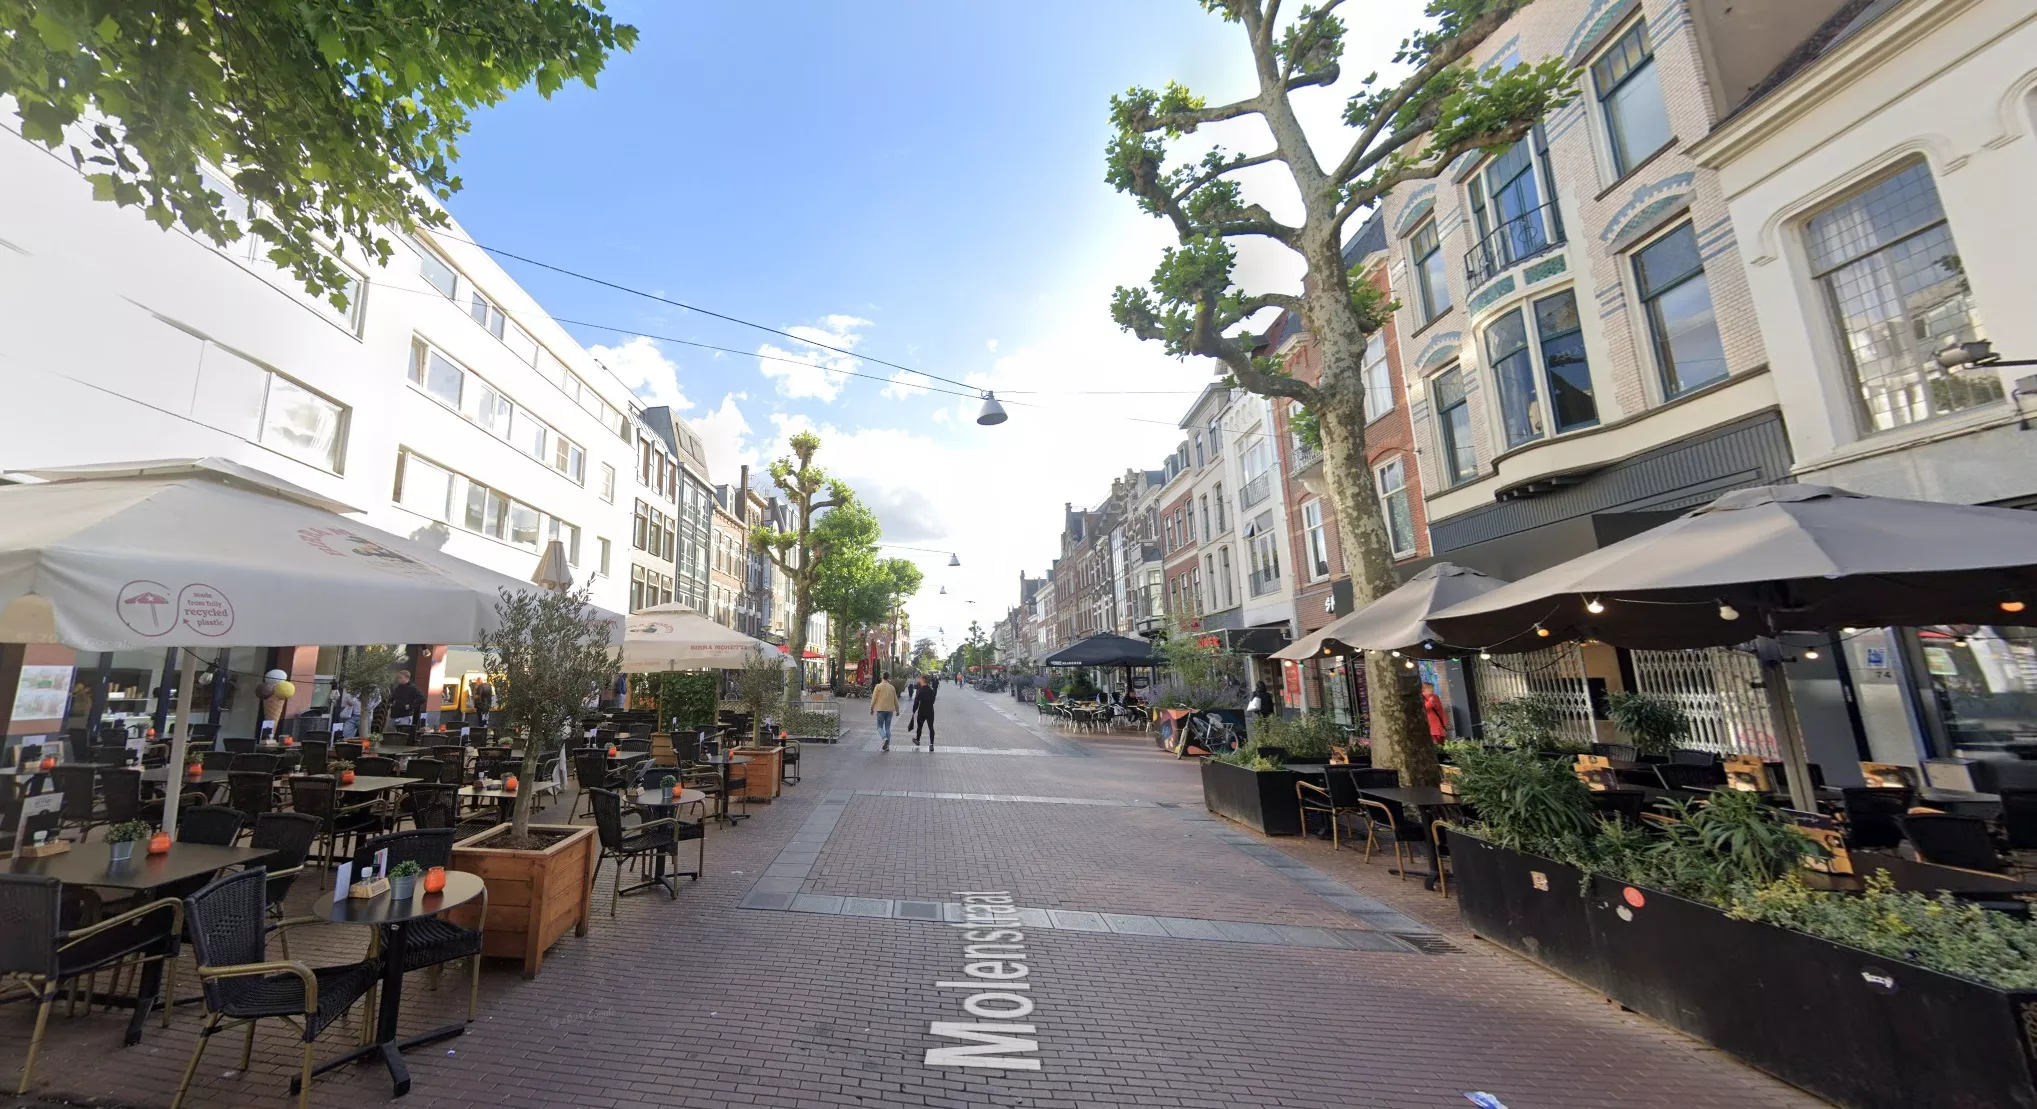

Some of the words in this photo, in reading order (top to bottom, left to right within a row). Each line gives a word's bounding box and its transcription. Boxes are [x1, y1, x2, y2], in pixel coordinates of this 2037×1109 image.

[205, 600, 222, 608] fully
[184, 608, 229, 618] recycled
[196, 618, 225, 627] plastic
[1874, 671, 1893, 679] 74
